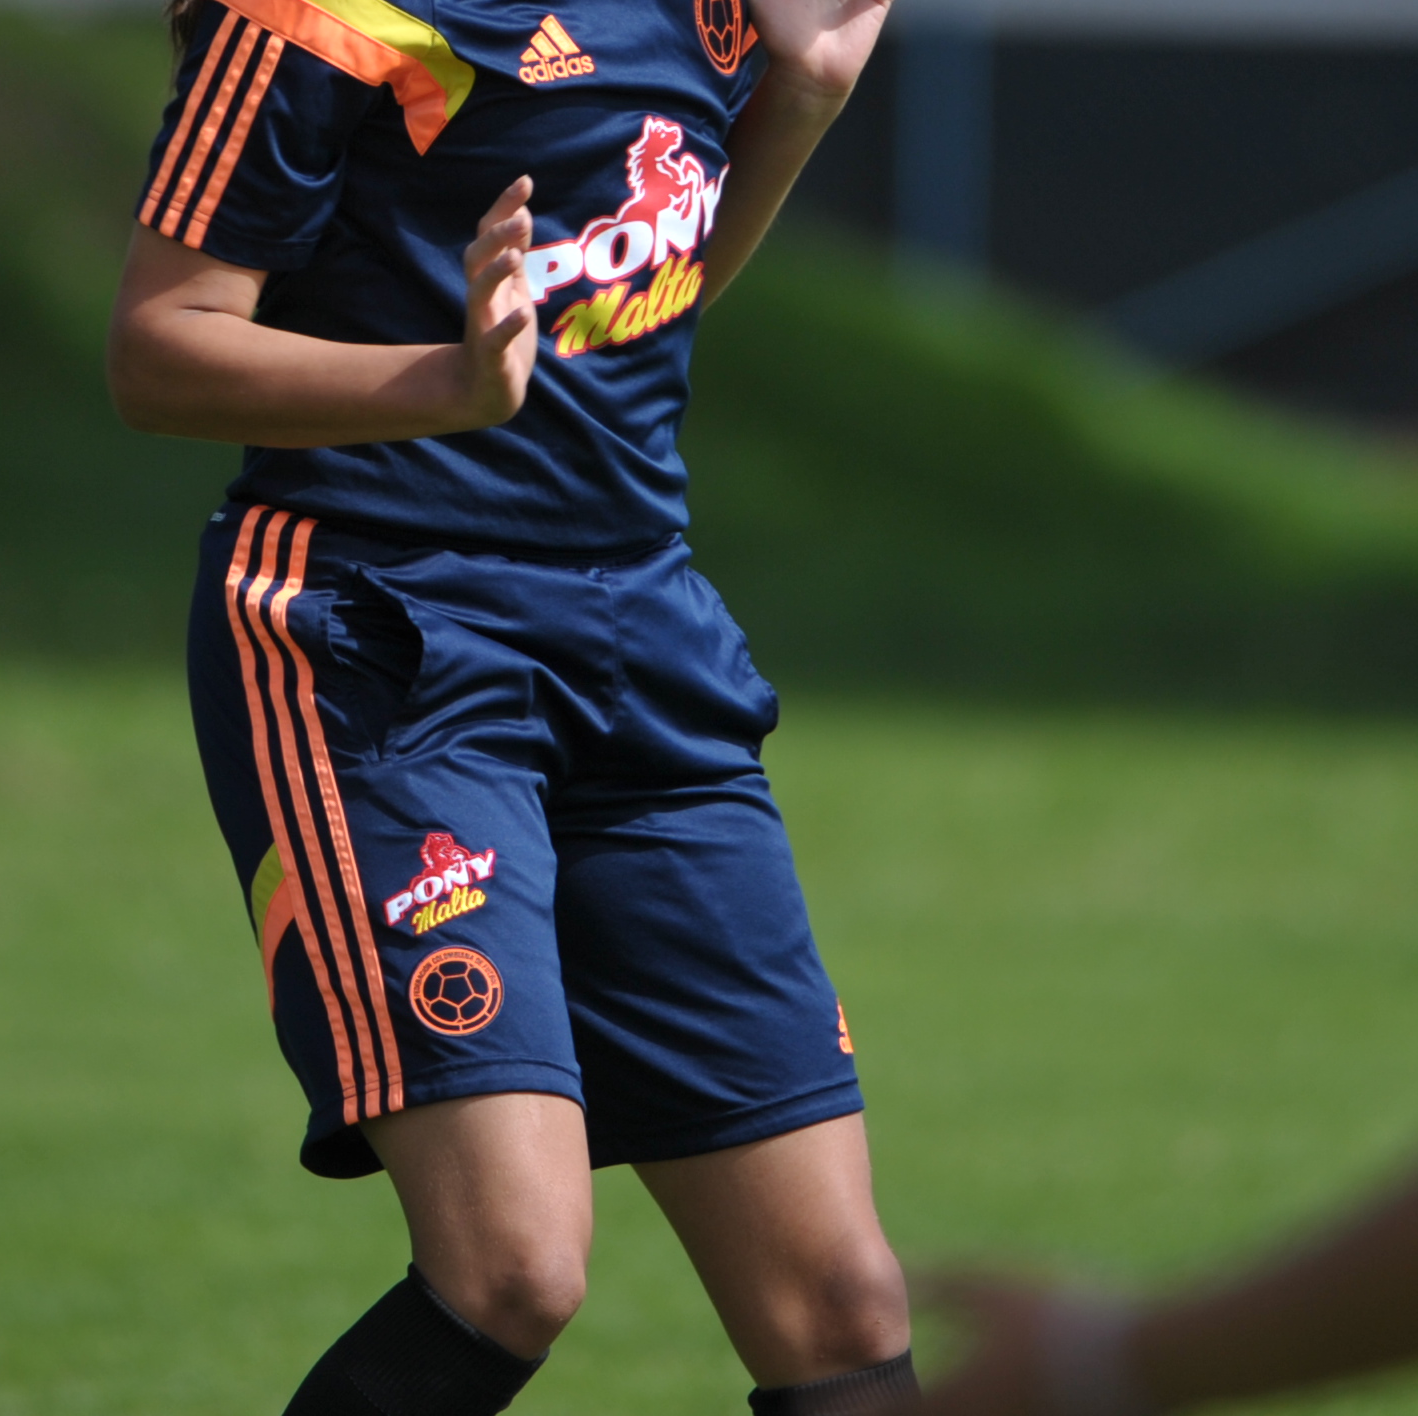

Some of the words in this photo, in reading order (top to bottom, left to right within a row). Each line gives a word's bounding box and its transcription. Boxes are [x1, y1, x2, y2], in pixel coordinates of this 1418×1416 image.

[518, 54, 596, 84] adidas
[551, 253, 704, 357] Malta
[384, 849, 495, 925] PONY
[411, 886, 486, 934] Malta
